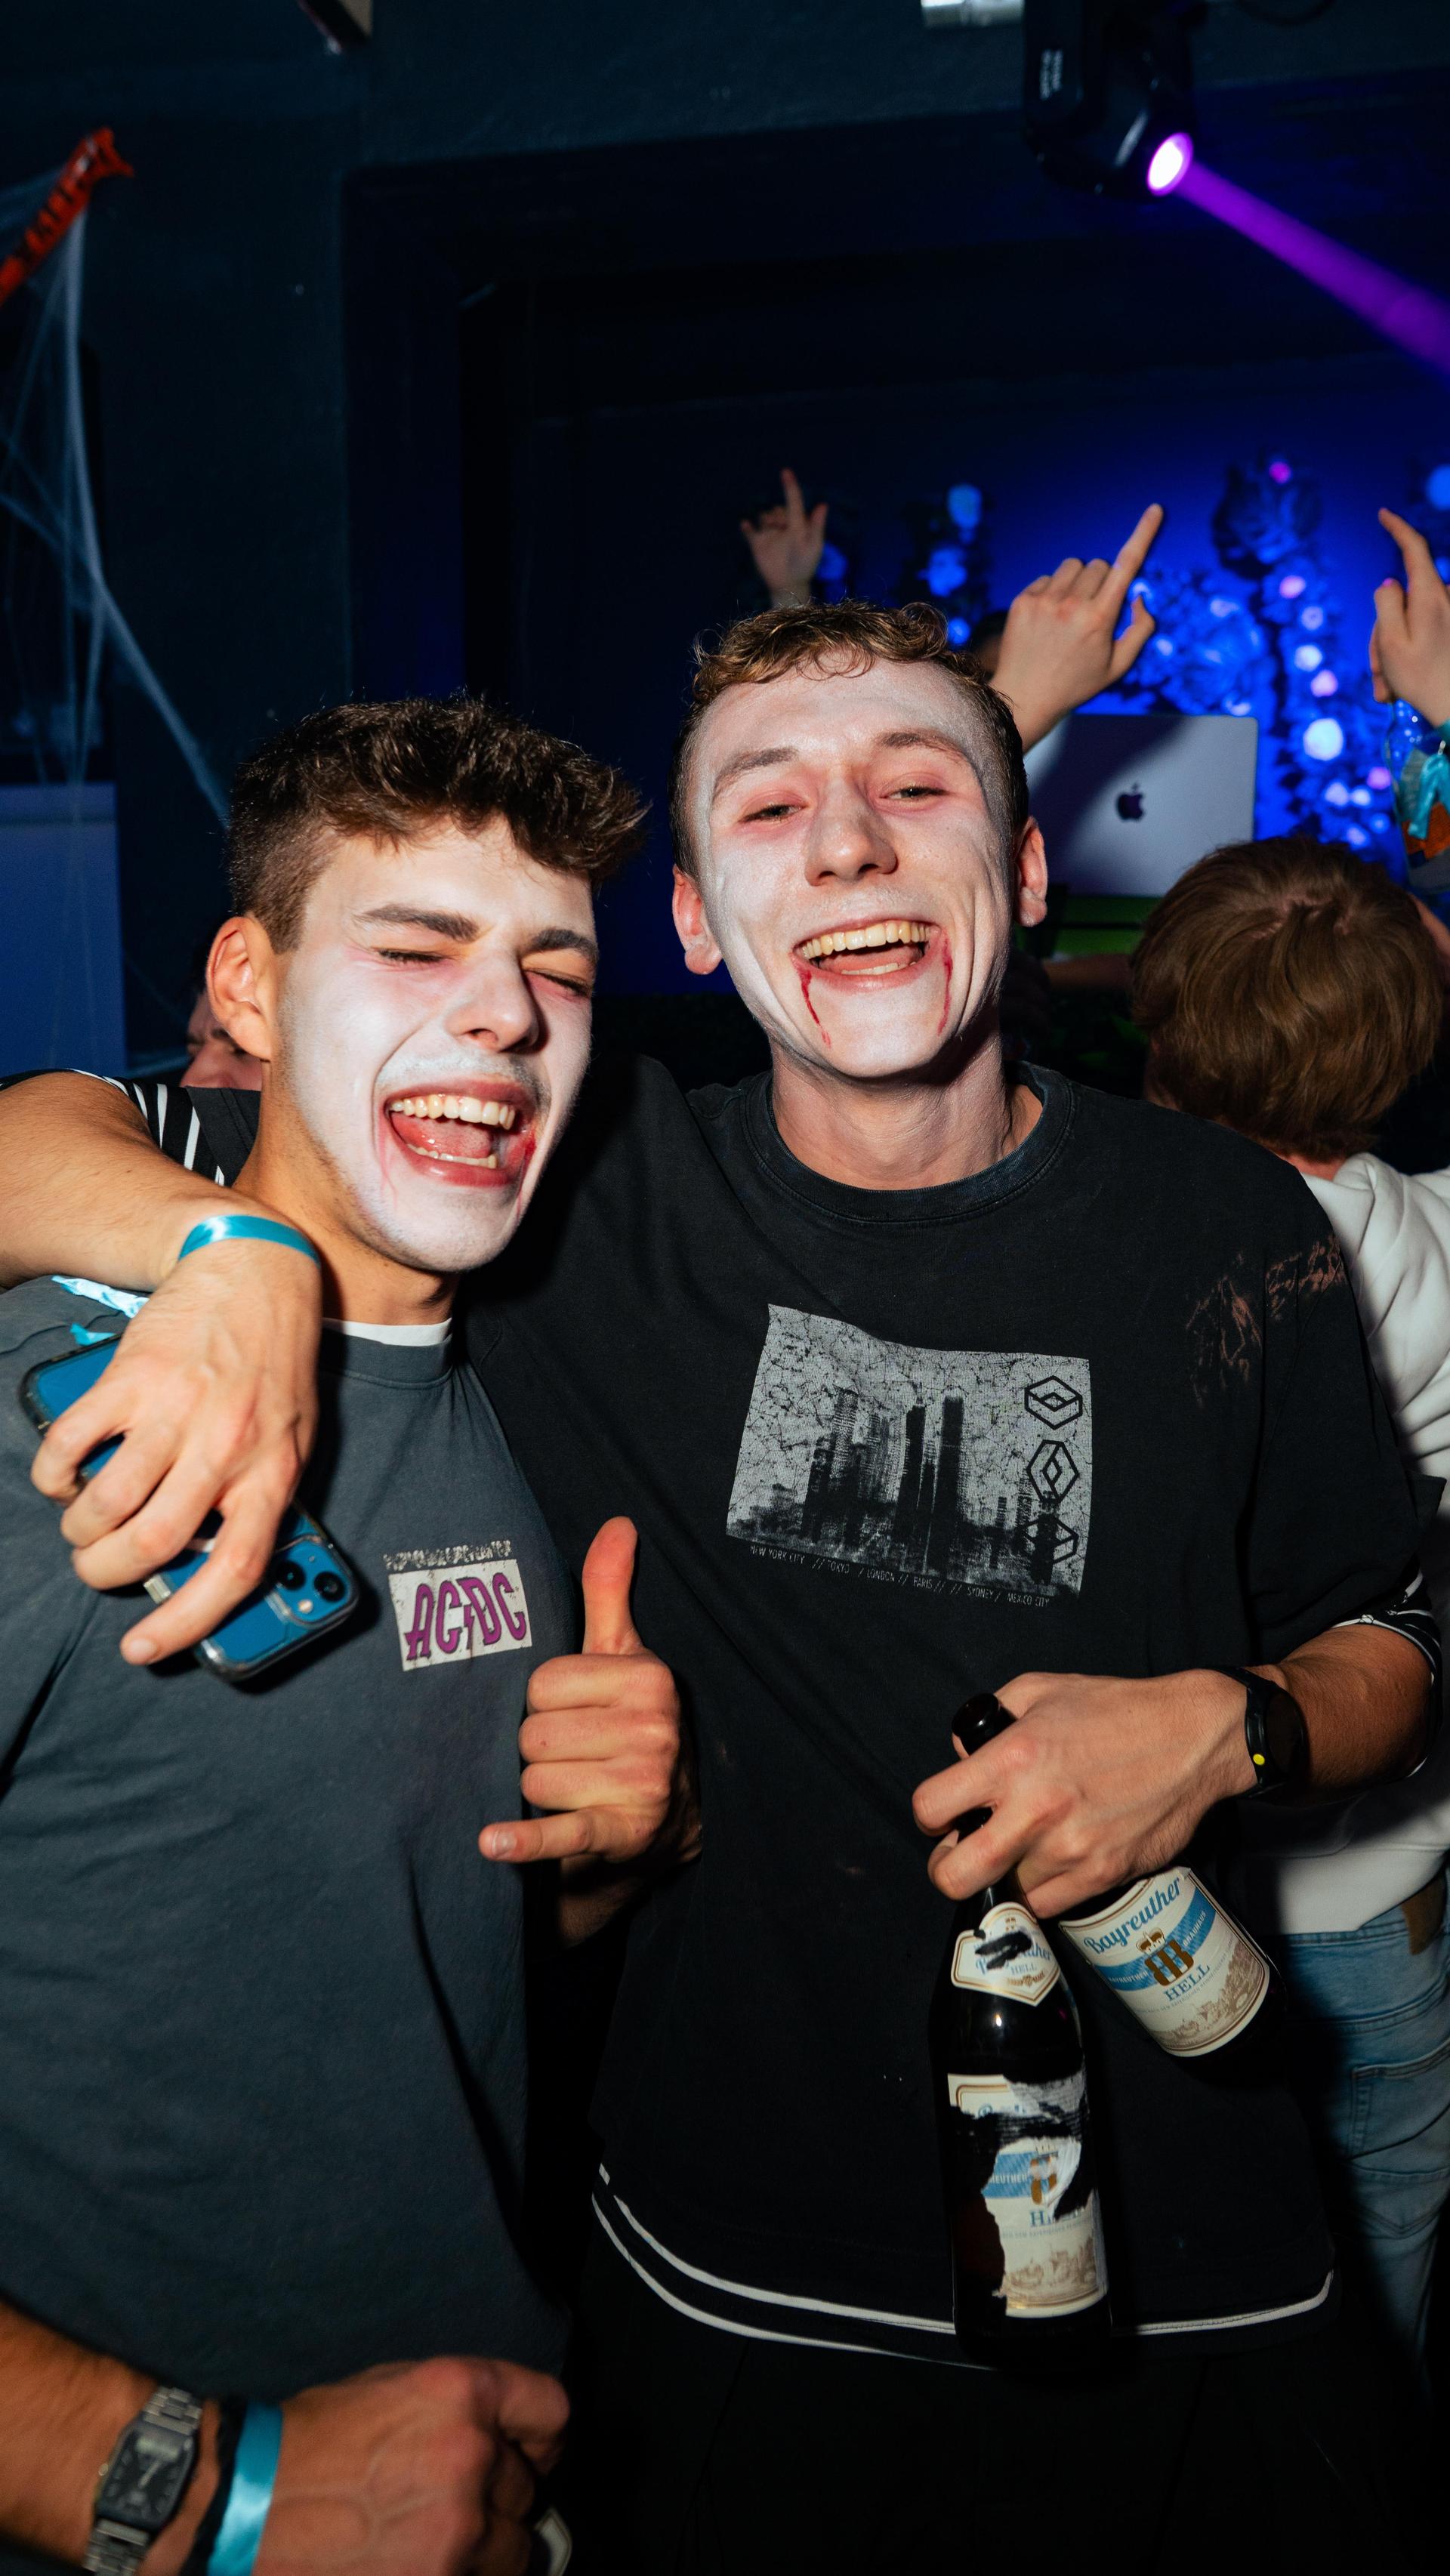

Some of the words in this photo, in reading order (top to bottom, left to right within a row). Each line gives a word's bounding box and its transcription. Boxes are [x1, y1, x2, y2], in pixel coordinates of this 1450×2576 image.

[769, 1548, 787, 1561] YORK
[866, 1569, 895, 1582] LONDON
[913, 1576, 933, 1589] PARIS
[967, 1586, 994, 1599] SYDNEY
[1007, 1592, 1033, 1606] MEXICO
[1035, 1596, 1050, 1607] CITY
[1083, 1875, 1182, 1954] Bayreuther
[1182, 1910, 1208, 1948] BRAUHAUS
[1163, 1963, 1211, 2002] HELL
